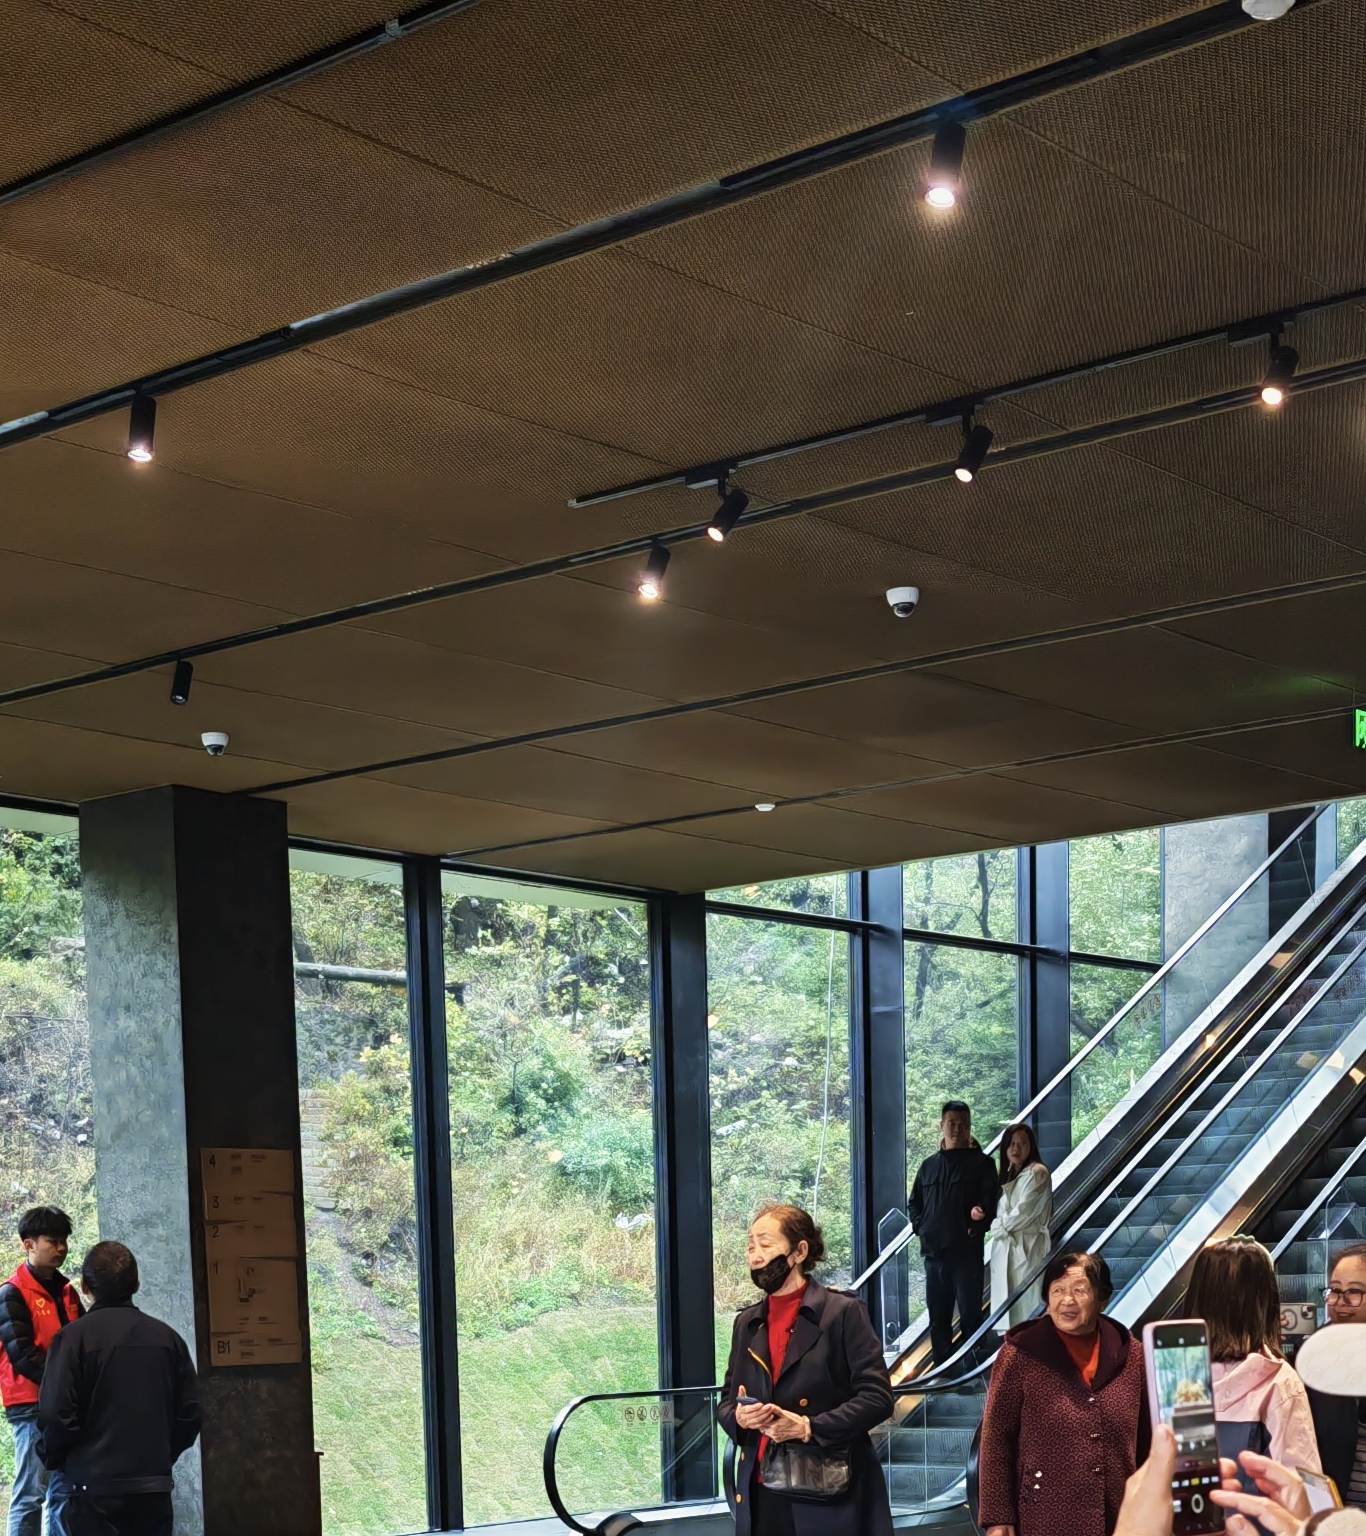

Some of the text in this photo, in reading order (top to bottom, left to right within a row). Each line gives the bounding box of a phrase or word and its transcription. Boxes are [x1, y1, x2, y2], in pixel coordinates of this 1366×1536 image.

[209, 1154, 216, 1166] 4
[213, 1195, 219, 1208] 3
[212, 1225, 219, 1238] 2
[217, 1340, 231, 1354] B1
